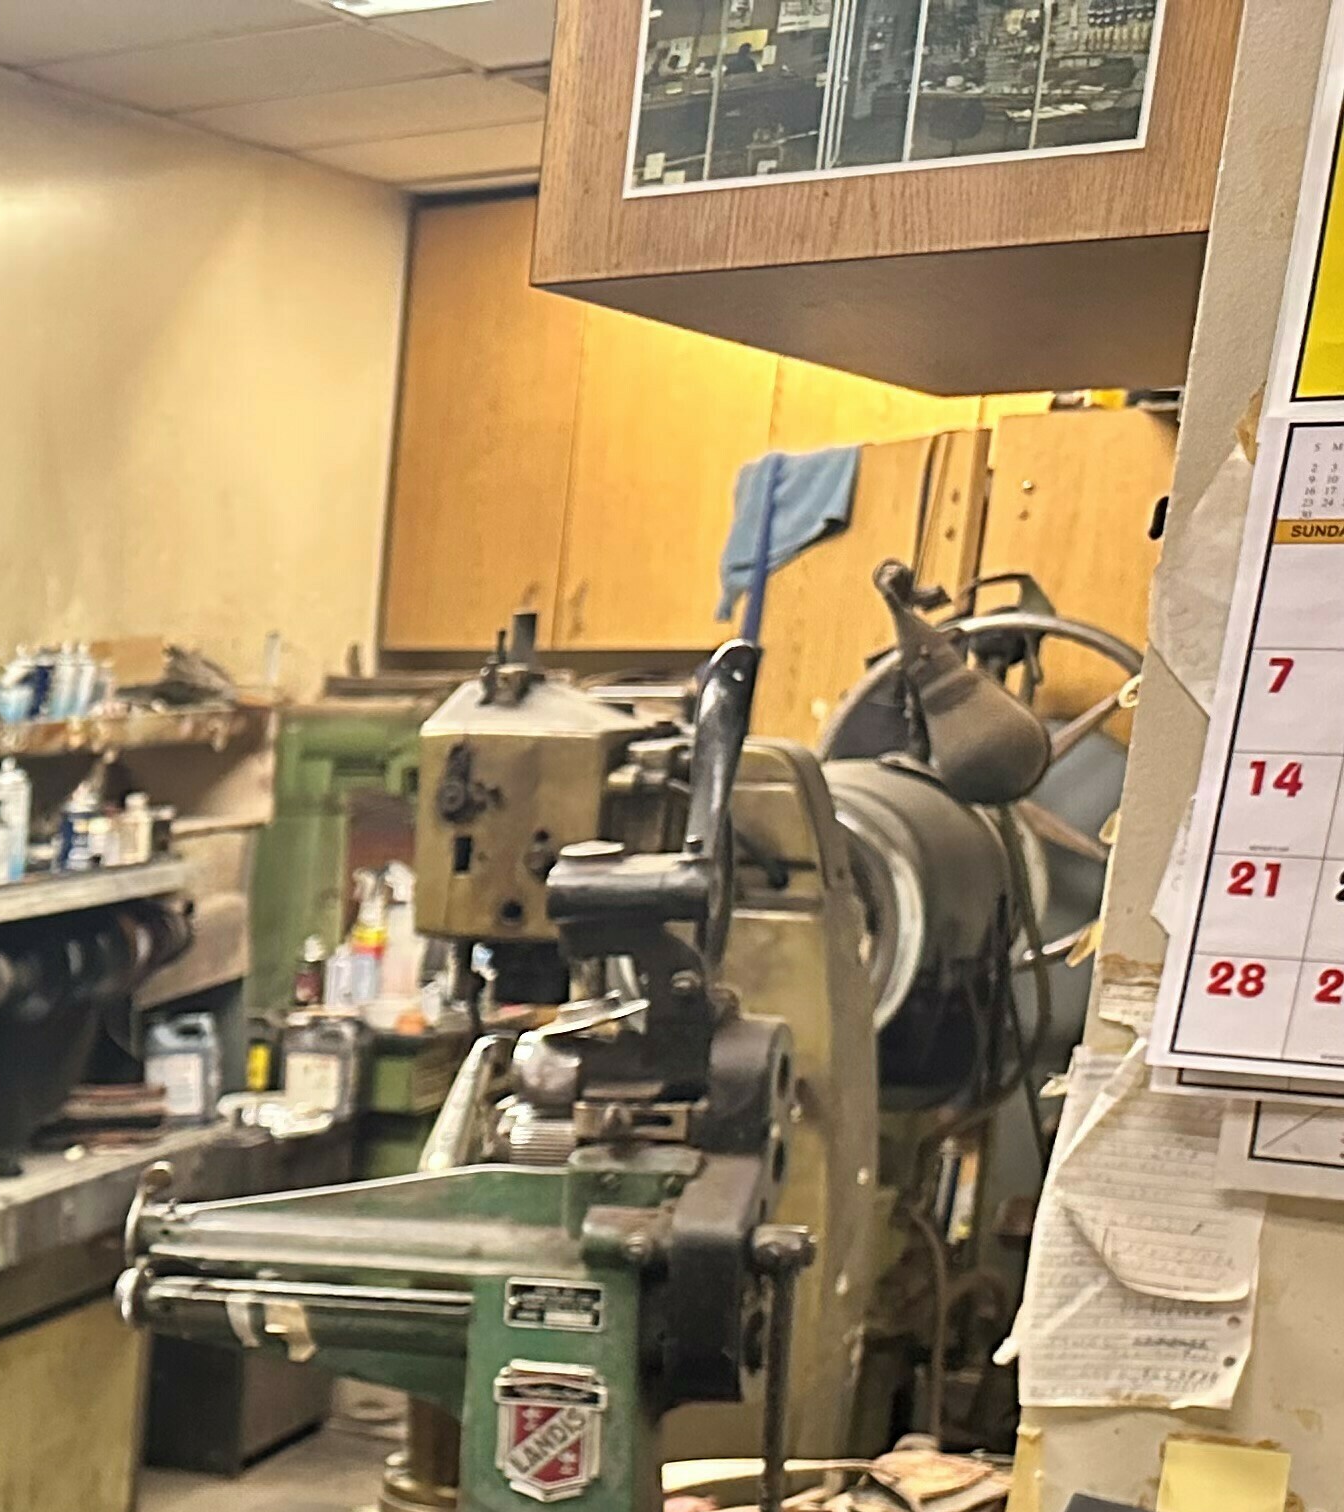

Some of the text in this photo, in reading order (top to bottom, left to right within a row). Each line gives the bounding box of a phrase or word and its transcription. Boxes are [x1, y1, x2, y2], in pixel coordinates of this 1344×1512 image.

[1268, 657, 1295, 694] 7
[1249, 760, 1303, 798] 14
[1227, 861, 1281, 897] 21
[1206, 961, 1266, 998] 28
[1314, 968, 1344, 1005] 2
